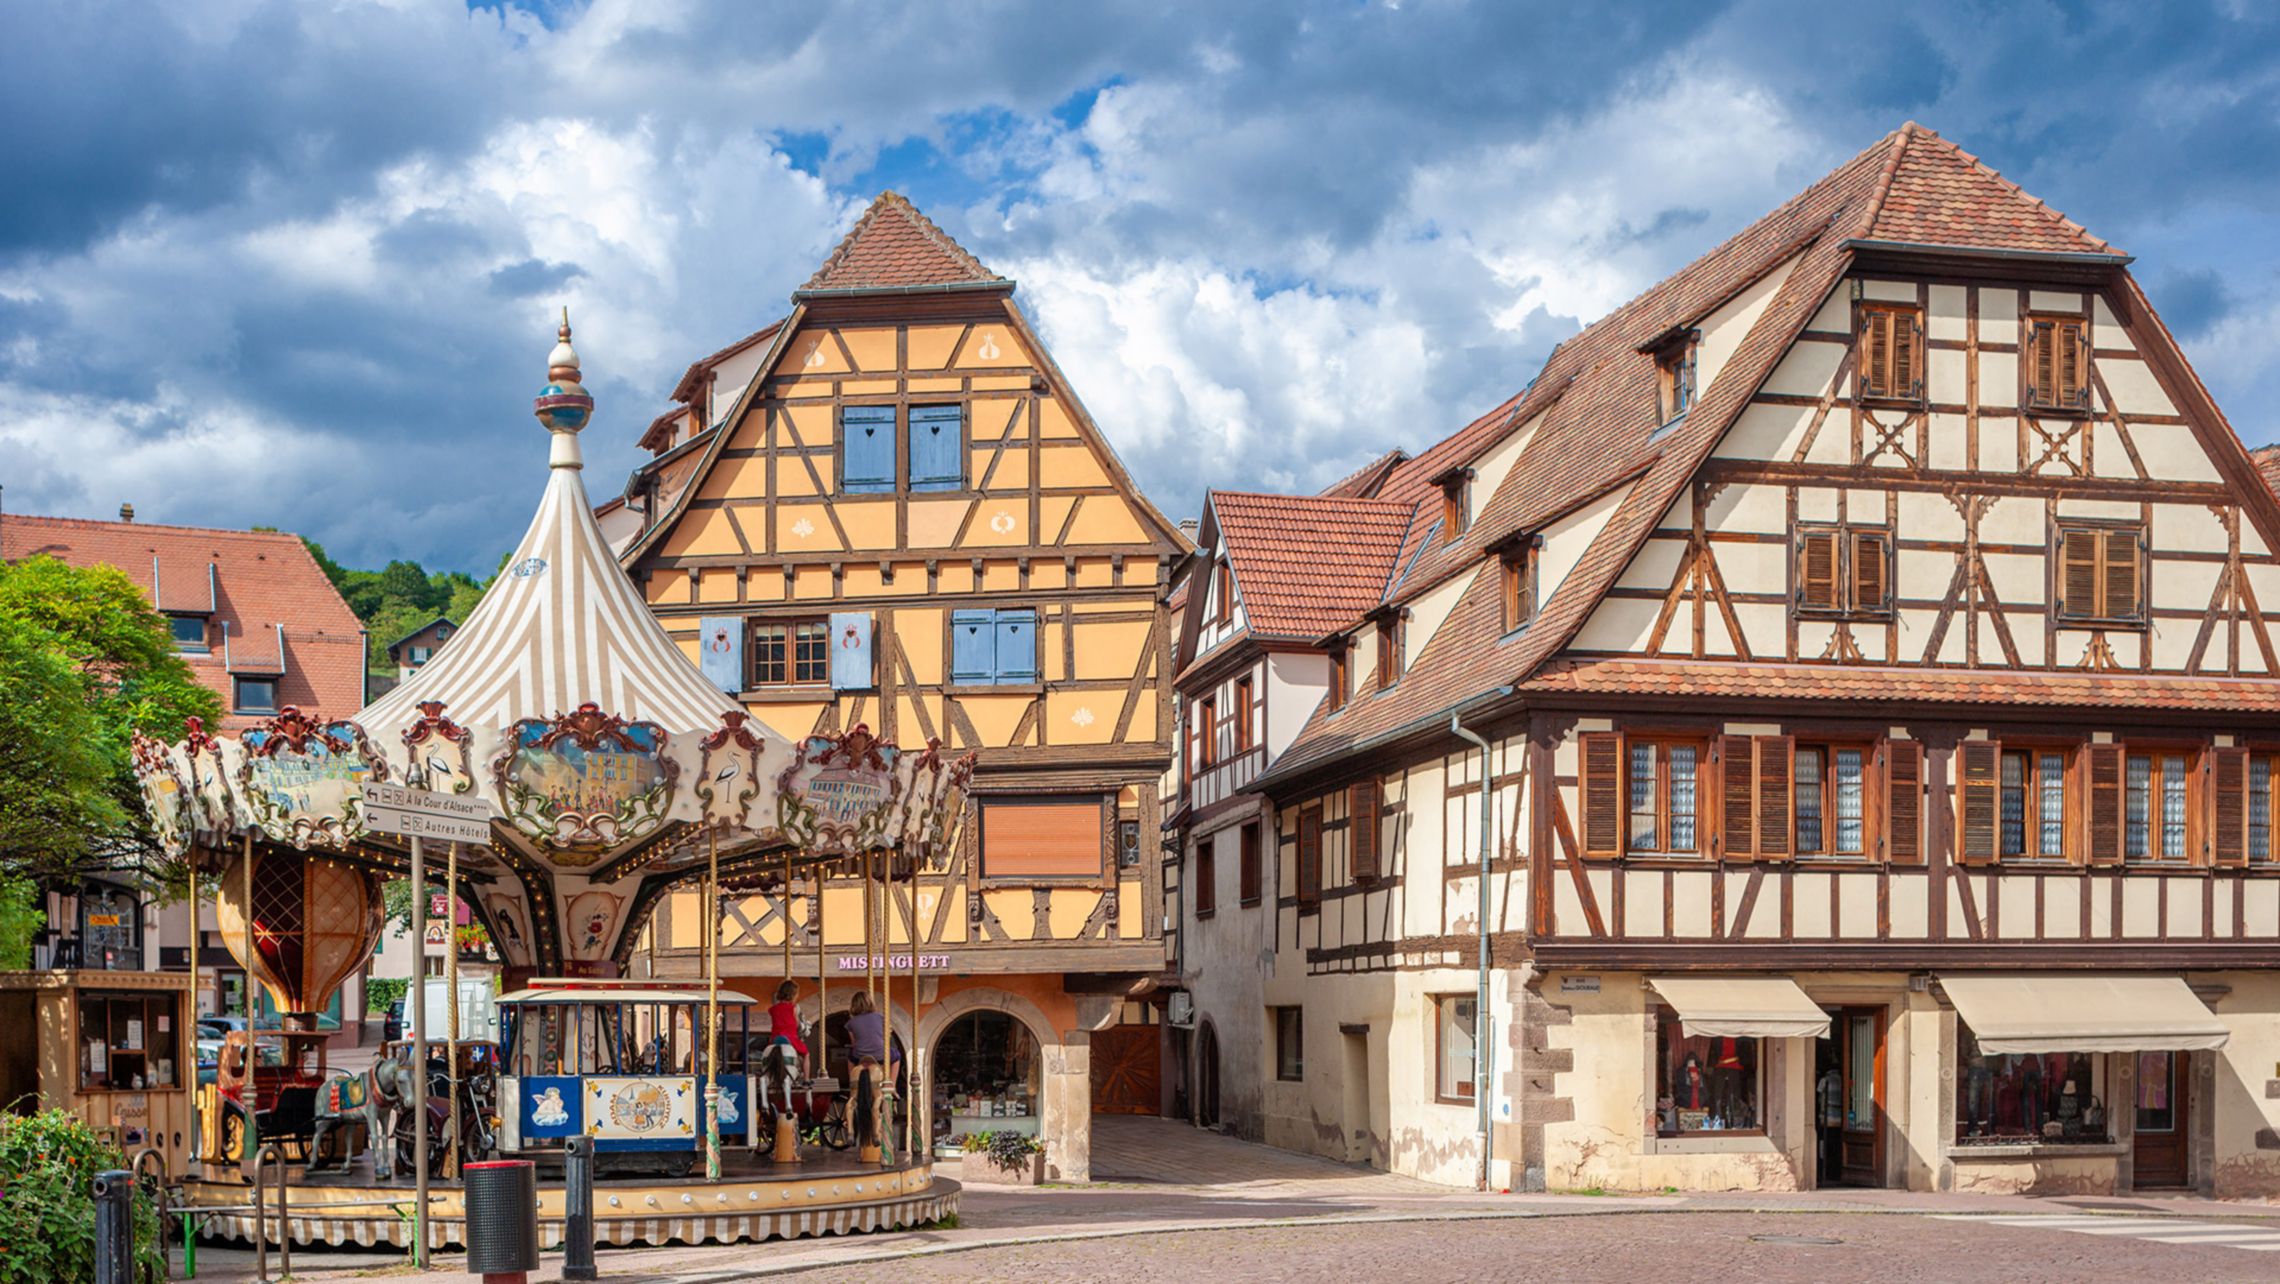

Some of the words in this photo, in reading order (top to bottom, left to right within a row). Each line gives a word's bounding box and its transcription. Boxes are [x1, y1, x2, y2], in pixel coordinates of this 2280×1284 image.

[414, 795, 421, 806] la
[424, 797, 441, 810] Cour
[425, 821, 456, 834] Autres
[609, 1094, 621, 1126] ADAM
